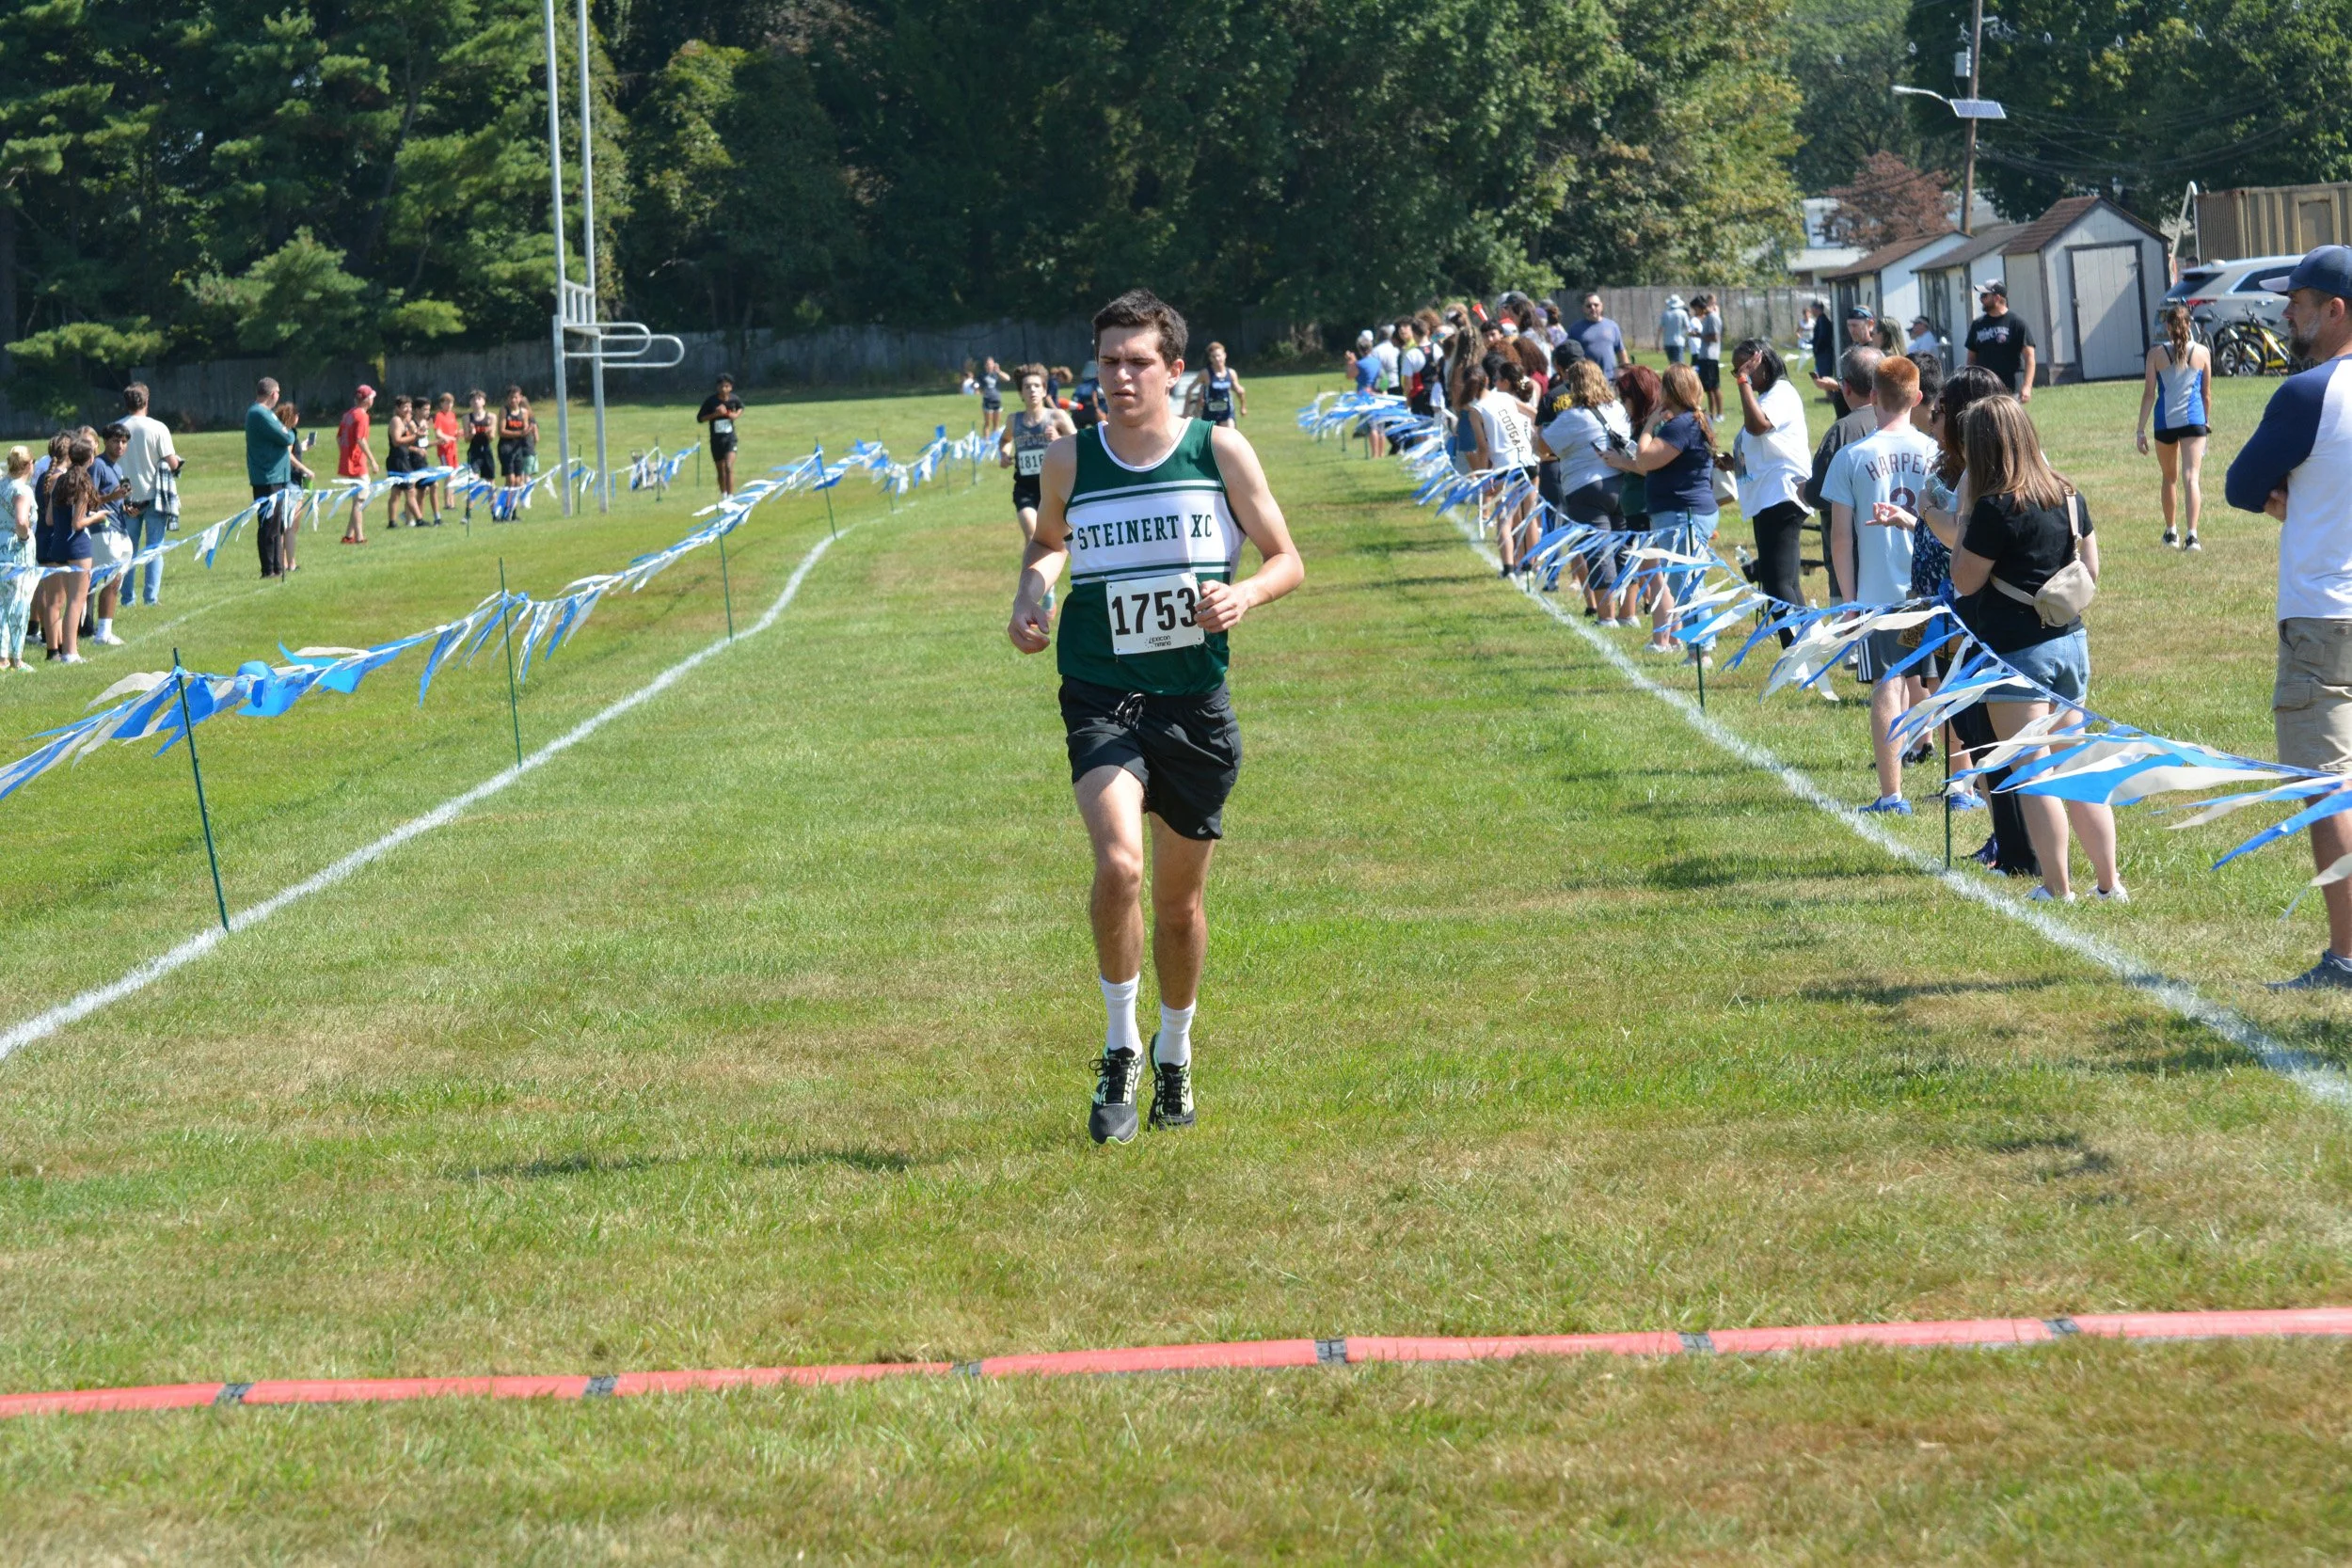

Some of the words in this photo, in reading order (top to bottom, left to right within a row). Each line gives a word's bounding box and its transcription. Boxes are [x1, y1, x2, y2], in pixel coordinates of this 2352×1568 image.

[1077, 515, 1180, 550] STEINERT
[1190, 514, 1213, 538] XC
[1111, 587, 1197, 636] 1753
